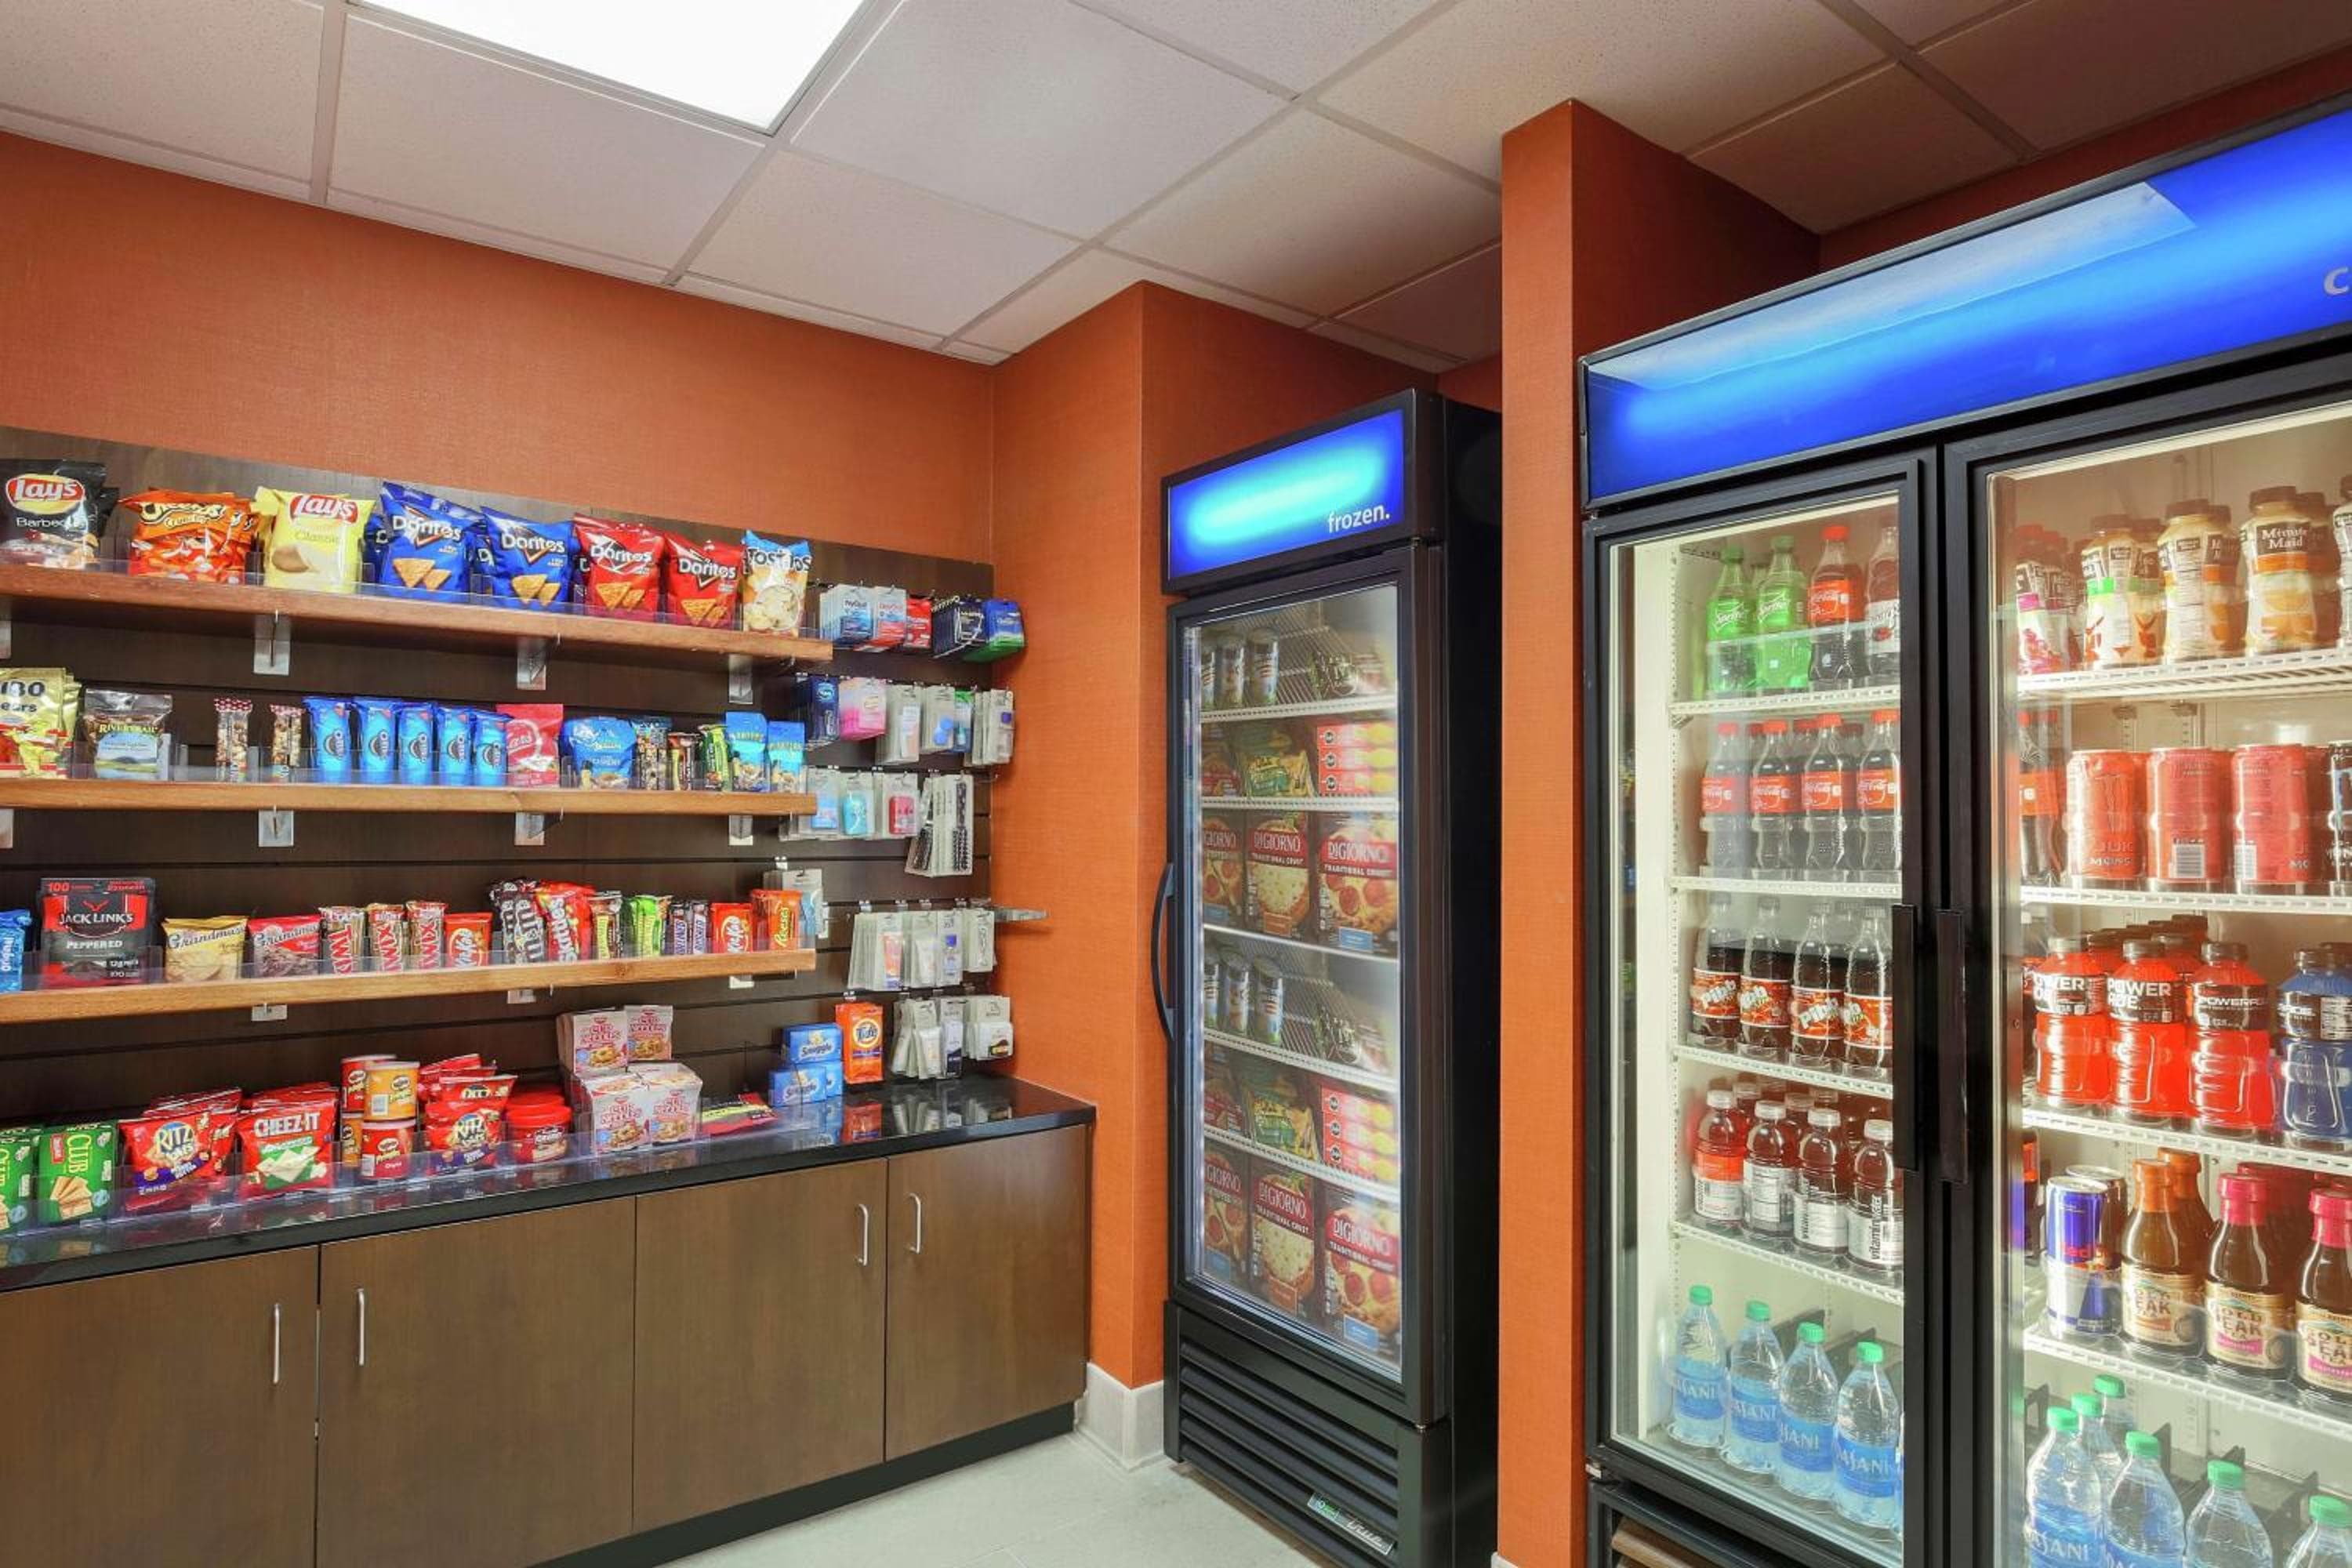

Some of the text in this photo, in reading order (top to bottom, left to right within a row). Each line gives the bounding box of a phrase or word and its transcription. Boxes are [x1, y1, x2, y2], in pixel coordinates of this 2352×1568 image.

[392, 514, 462, 541] Doritos
[1328, 504, 1390, 534] frozen.
[500, 532, 565, 554] Doritos
[590, 544, 653, 564] Doritos
[678, 559, 737, 579] Doritos
[59, 913, 93, 925] JACK
[65, 939, 123, 951] PEPPERED
[156, 1127, 194, 1149] RITZ
[66, 1133, 93, 1174] CLUB
